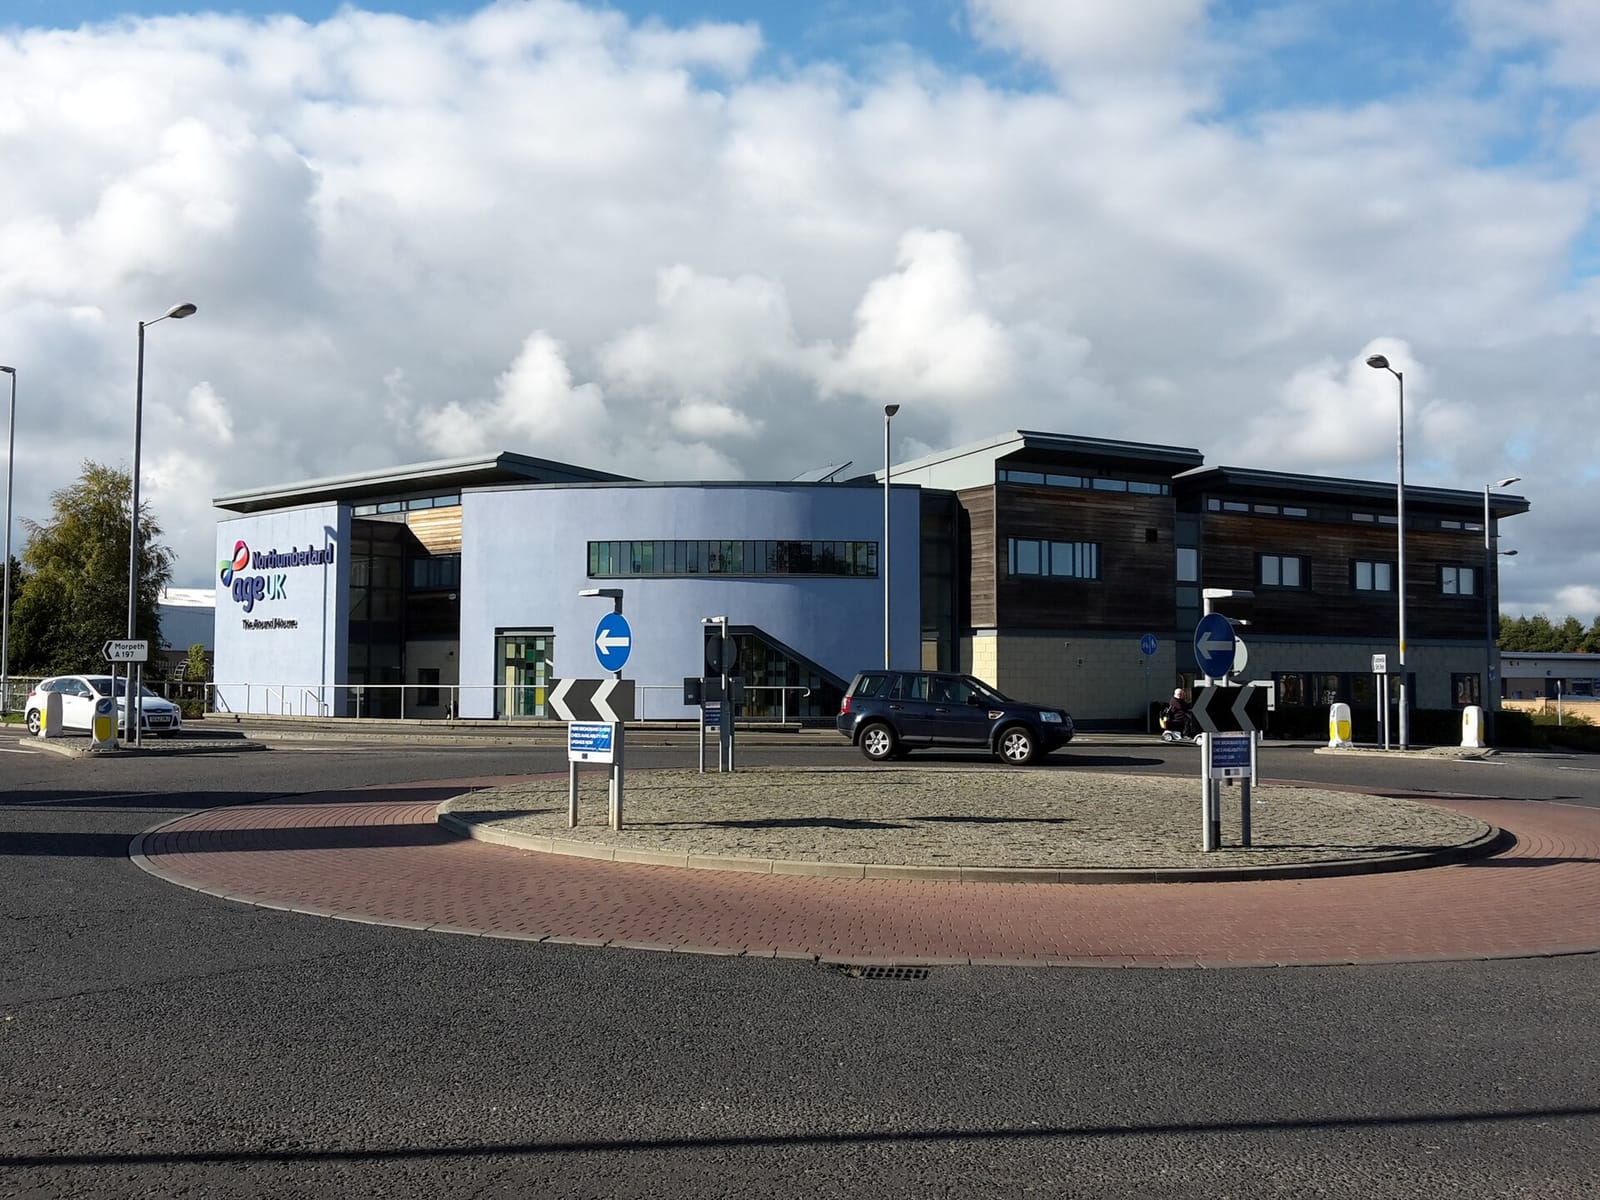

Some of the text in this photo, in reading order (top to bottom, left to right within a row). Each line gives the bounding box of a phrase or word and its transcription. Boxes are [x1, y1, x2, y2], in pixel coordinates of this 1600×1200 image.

[252, 543, 334, 570] Northumberland
[232, 574, 287, 613] age UK
